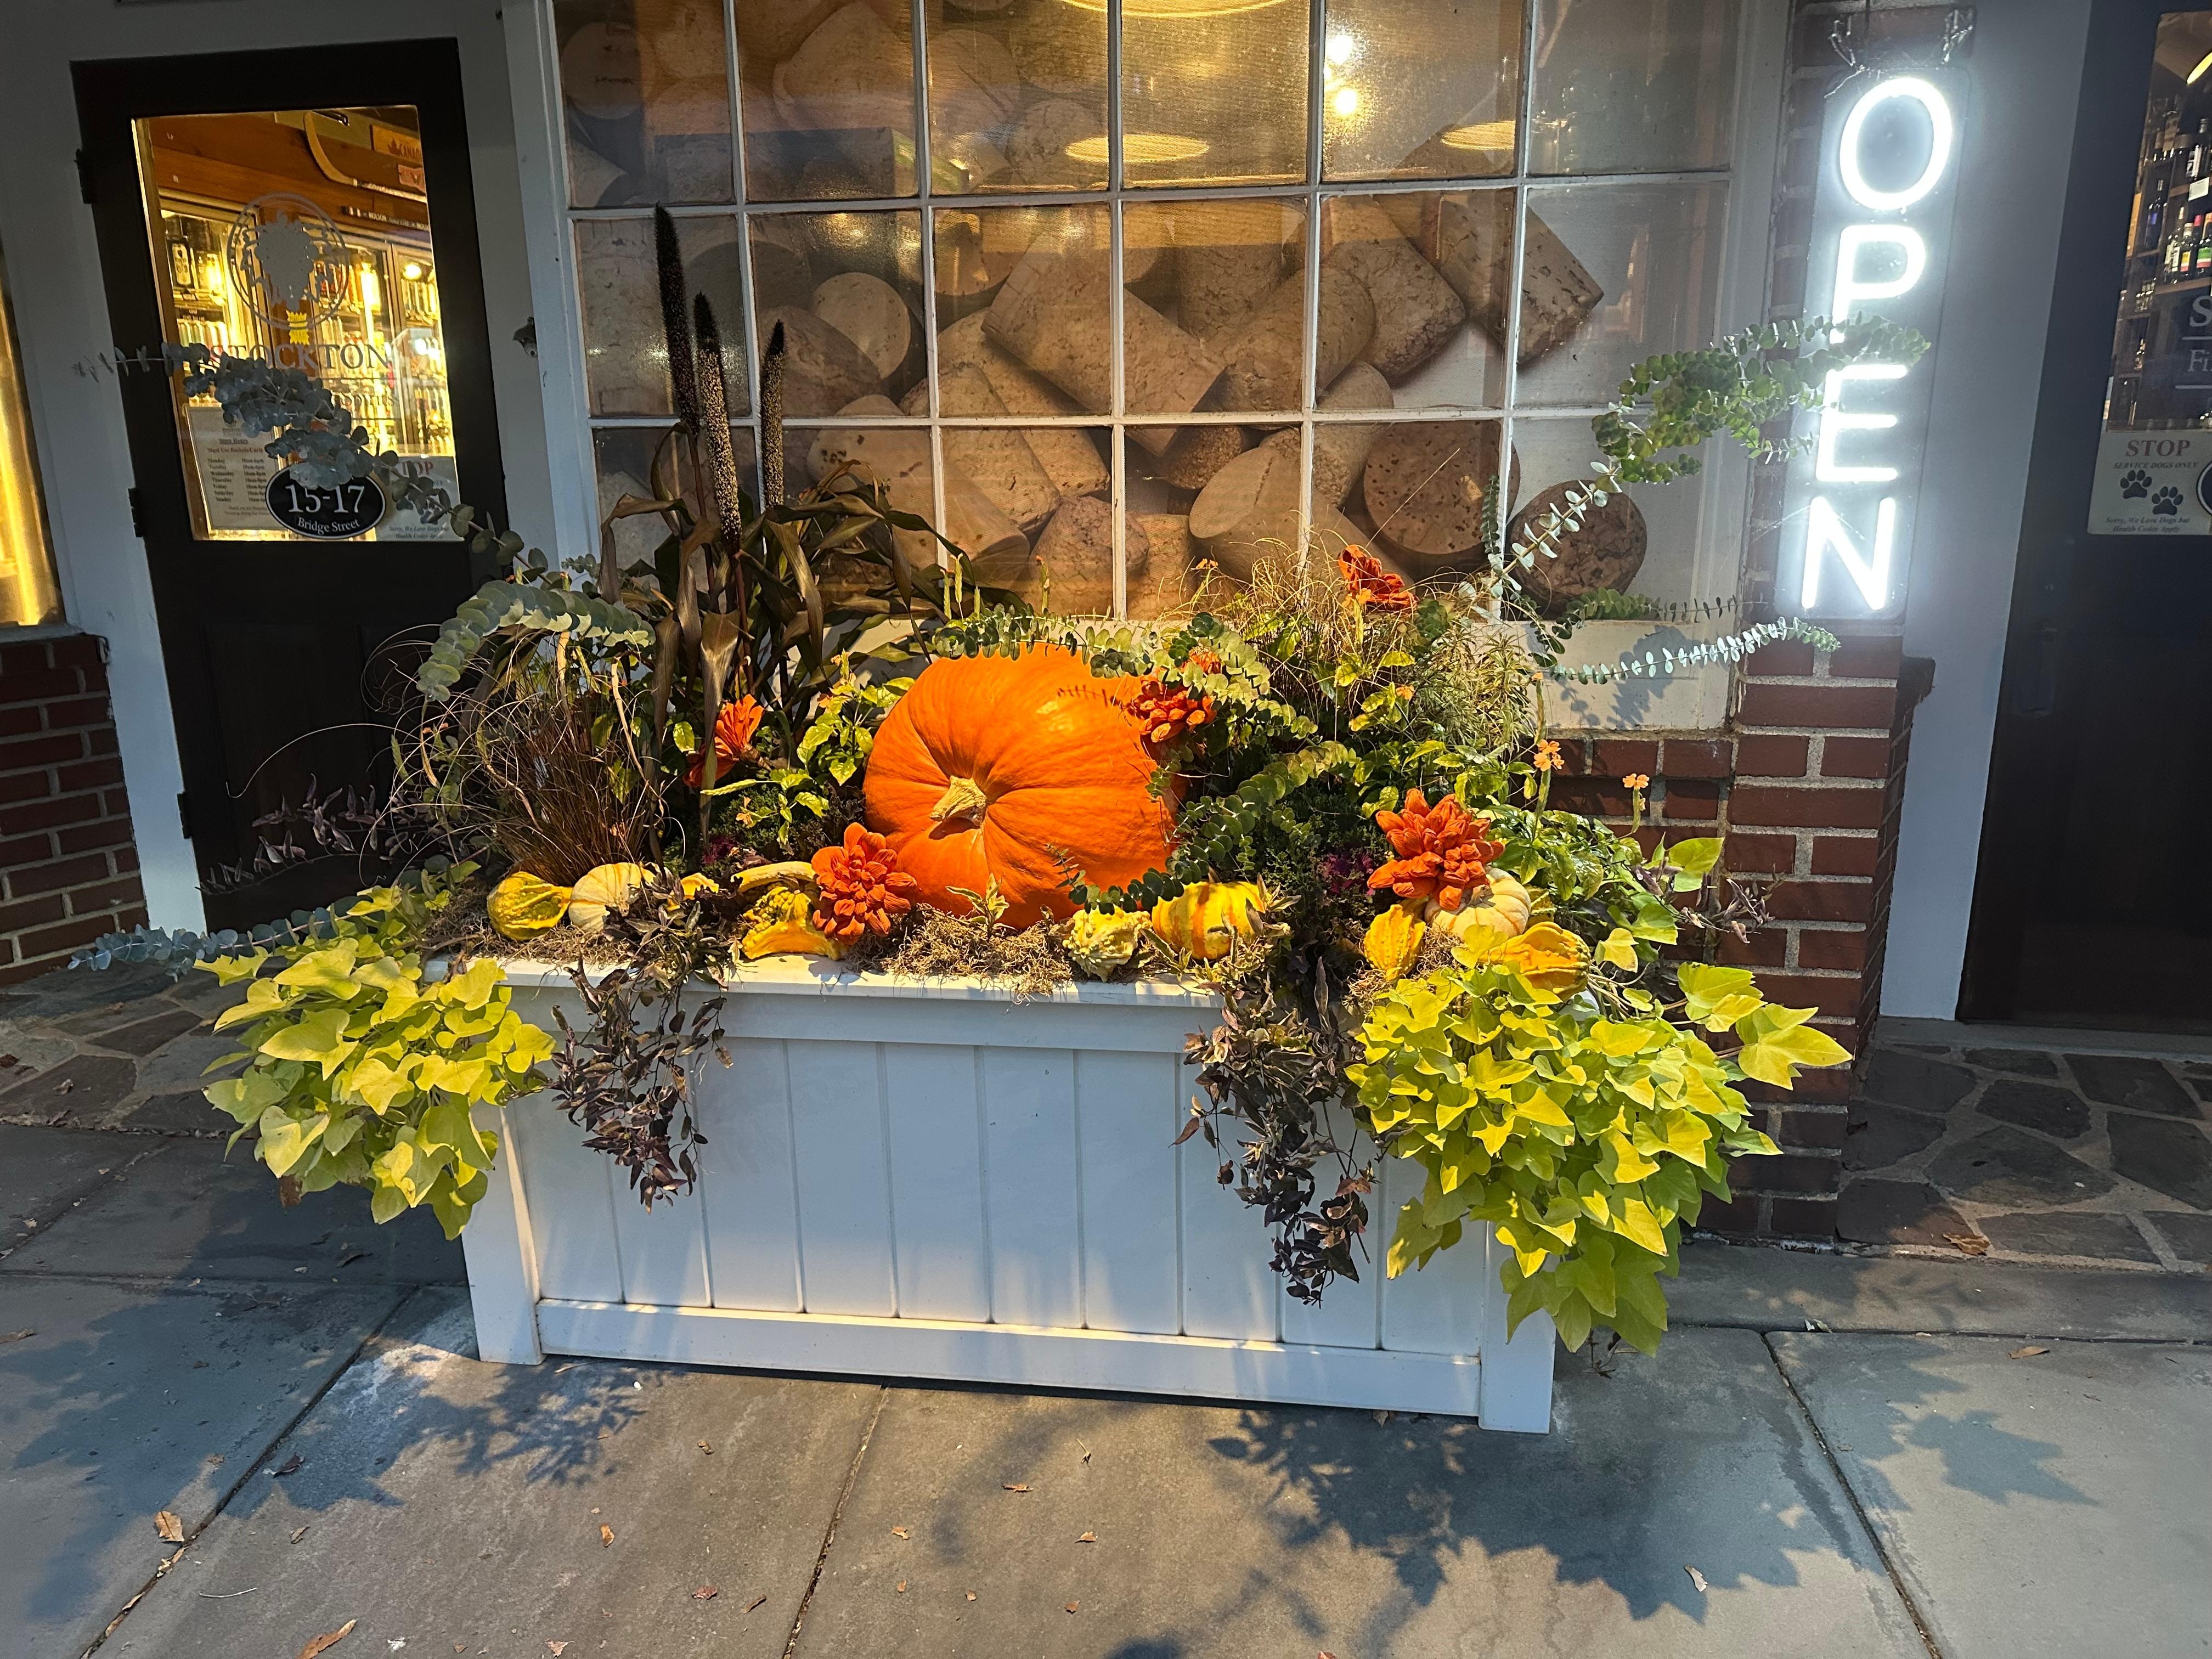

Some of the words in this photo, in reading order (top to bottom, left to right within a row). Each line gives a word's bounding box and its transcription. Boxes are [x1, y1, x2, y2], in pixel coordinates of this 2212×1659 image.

[211, 342, 388, 369] STOCKTON
[1801, 77, 1953, 611] OPEN
[2125, 439, 2191, 457] STOP
[399, 461, 434, 475] TOP
[285, 484, 365, 513] 15-17
[298, 516, 329, 535] Bridge
[331, 519, 360, 532] Street
